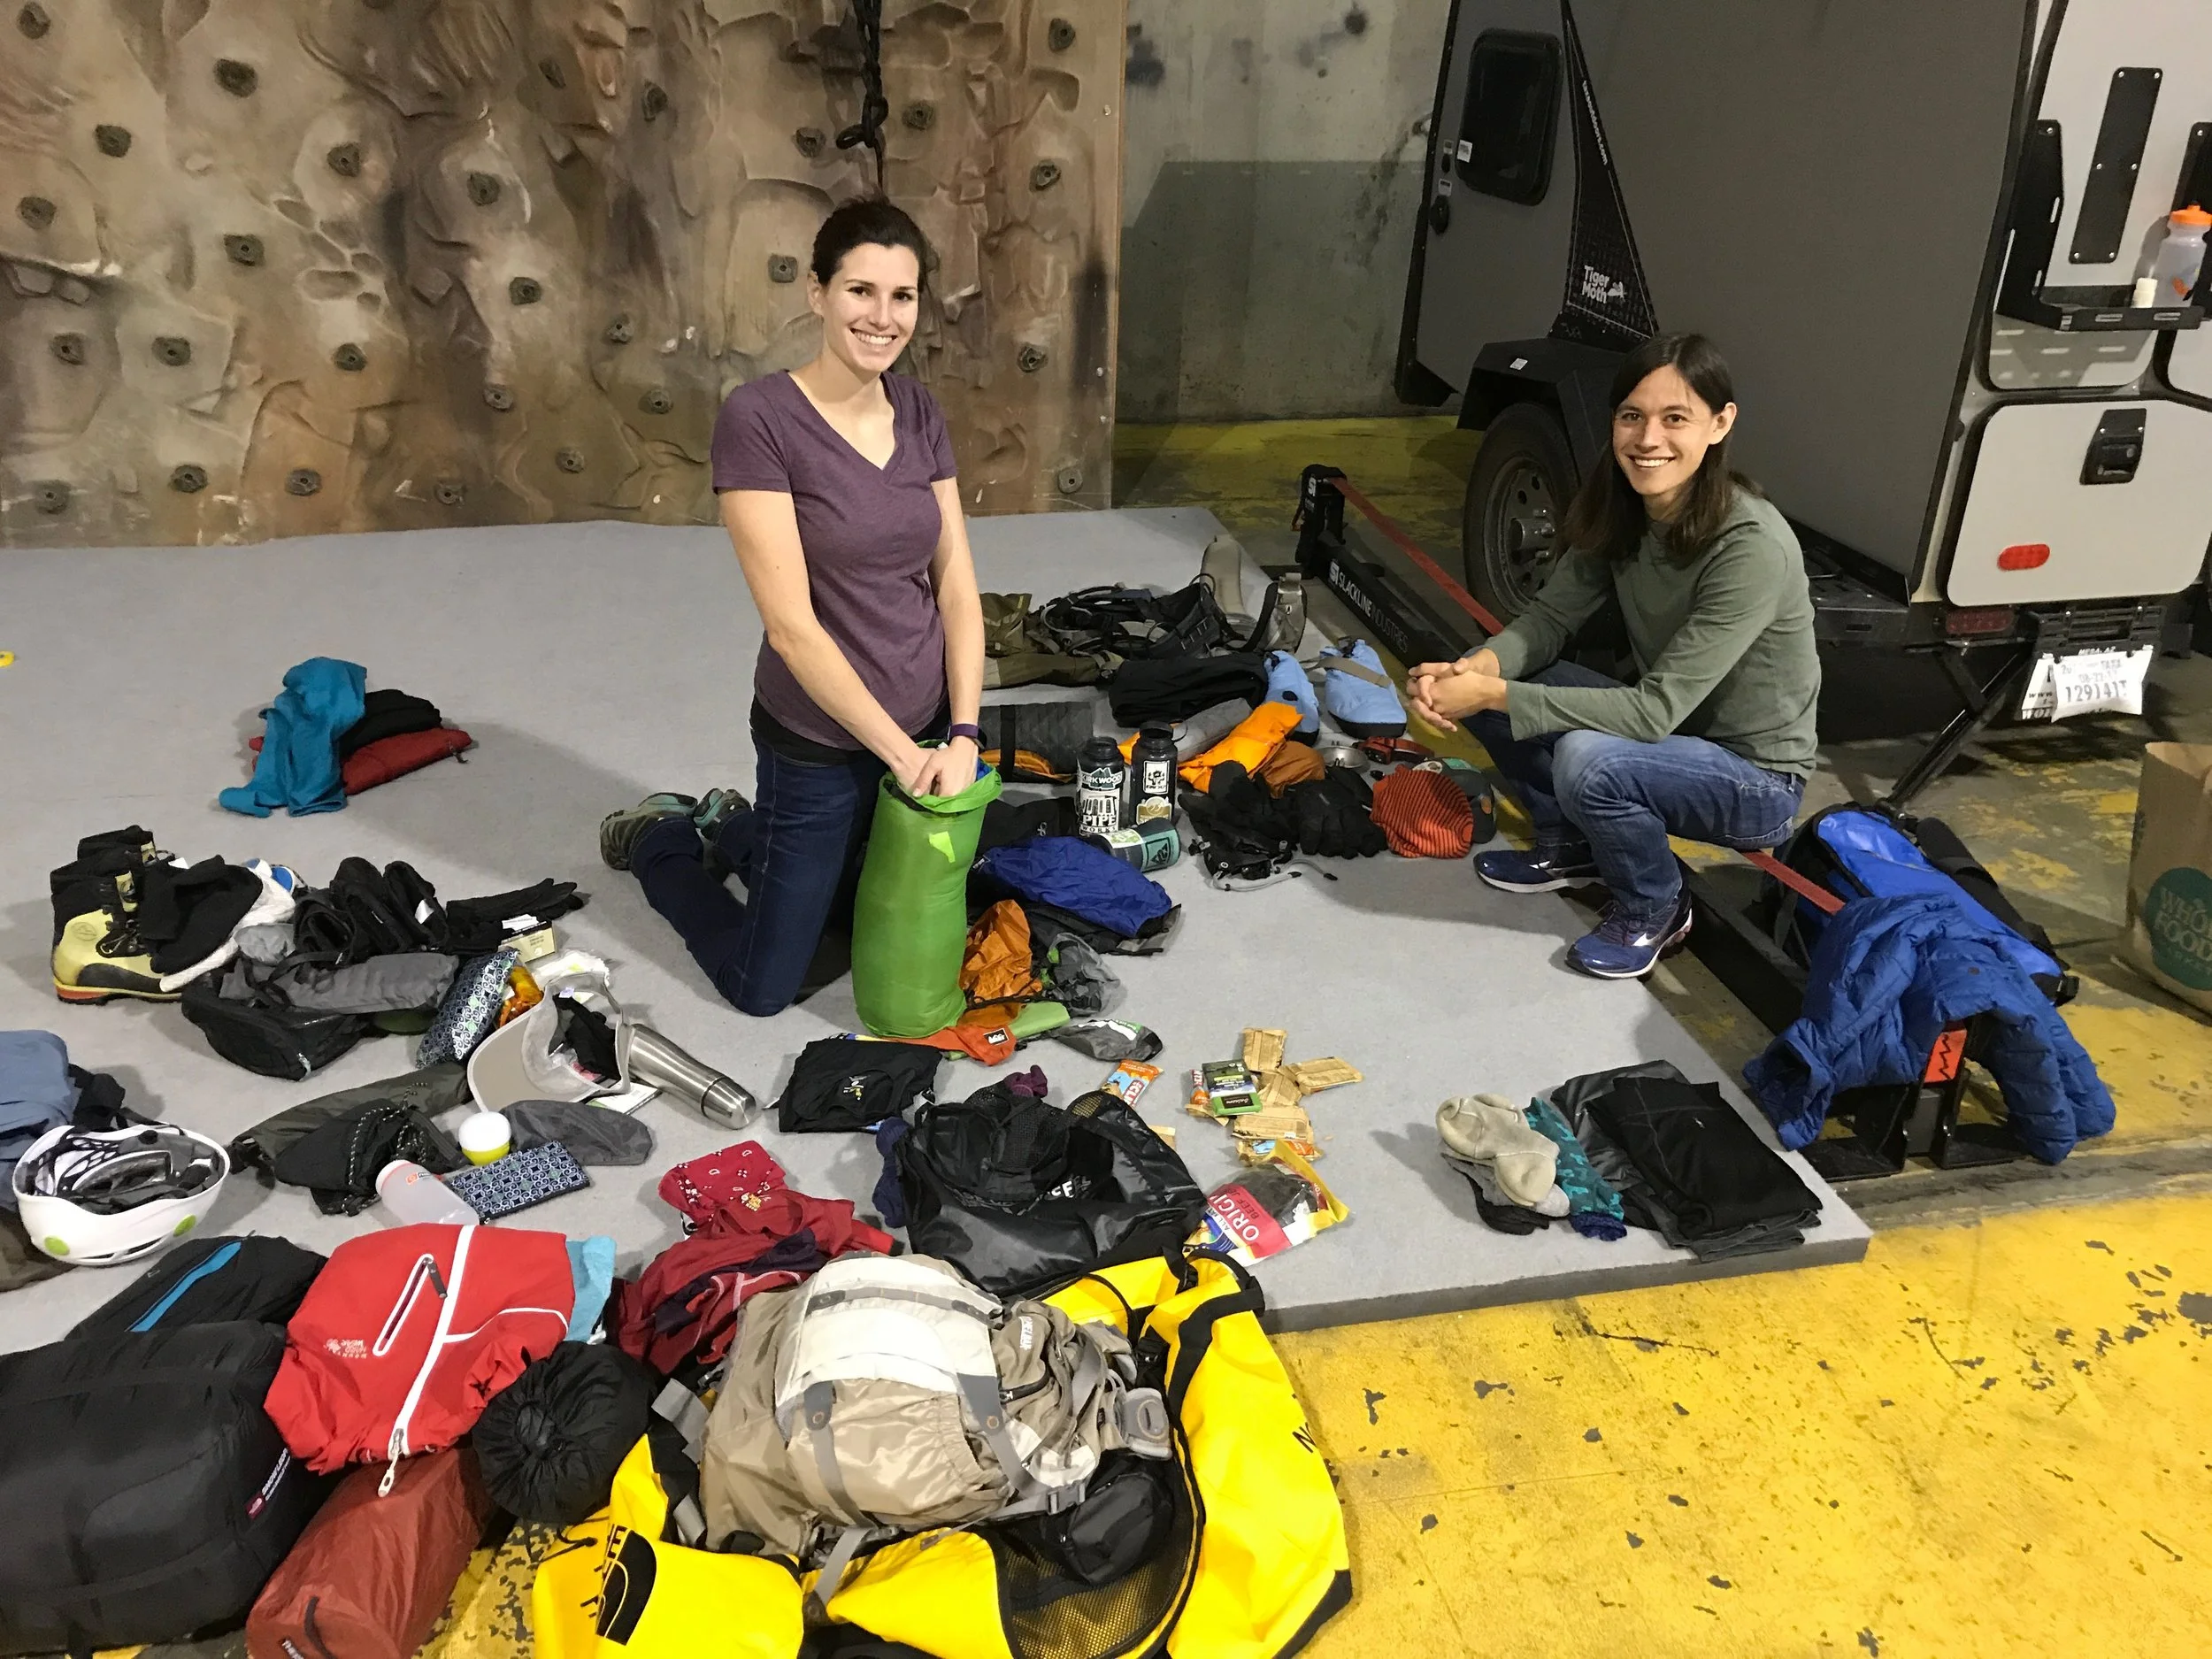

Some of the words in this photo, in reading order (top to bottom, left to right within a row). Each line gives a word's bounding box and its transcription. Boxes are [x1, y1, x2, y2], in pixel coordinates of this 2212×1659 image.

[1584, 265, 1609, 288] Tiger
[1581, 280, 1607, 303] Moth
[1339, 572, 1373, 618] SLACKLINE
[1371, 601, 1409, 654] INDUSTRIES
[1081, 773, 1122, 784] KIRKWOOD
[1082, 814, 1117, 826] PIPE
[1210, 1194, 1260, 1241] ORIGI
[1237, 1197, 1261, 1219] BEEF
